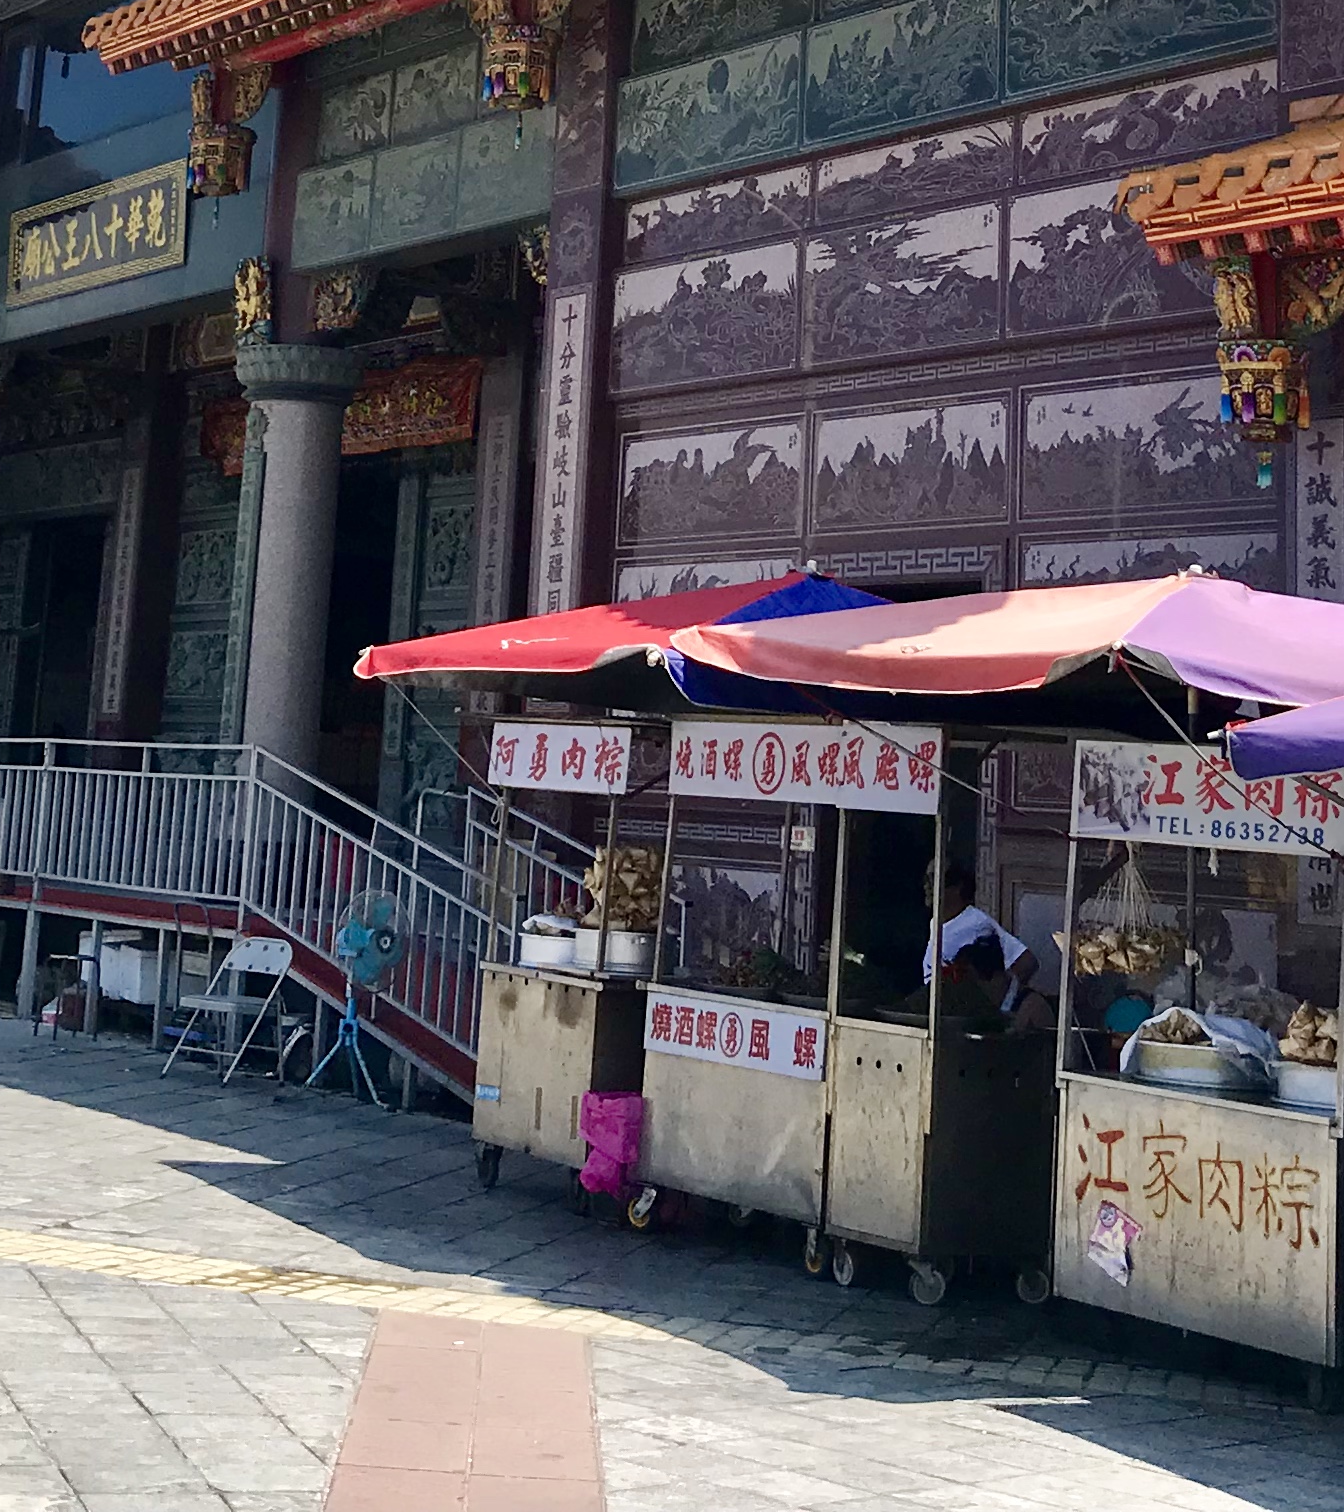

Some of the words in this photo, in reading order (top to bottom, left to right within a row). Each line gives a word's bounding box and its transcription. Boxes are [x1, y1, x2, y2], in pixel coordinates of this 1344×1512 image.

[495, 732, 623, 786] 阿勇肉粽
[1141, 753, 1343, 824] 江家肉粽
[650, 1001, 718, 1051] 燒酒螺
[1074, 1113, 1321, 1251] 江家肉粽
